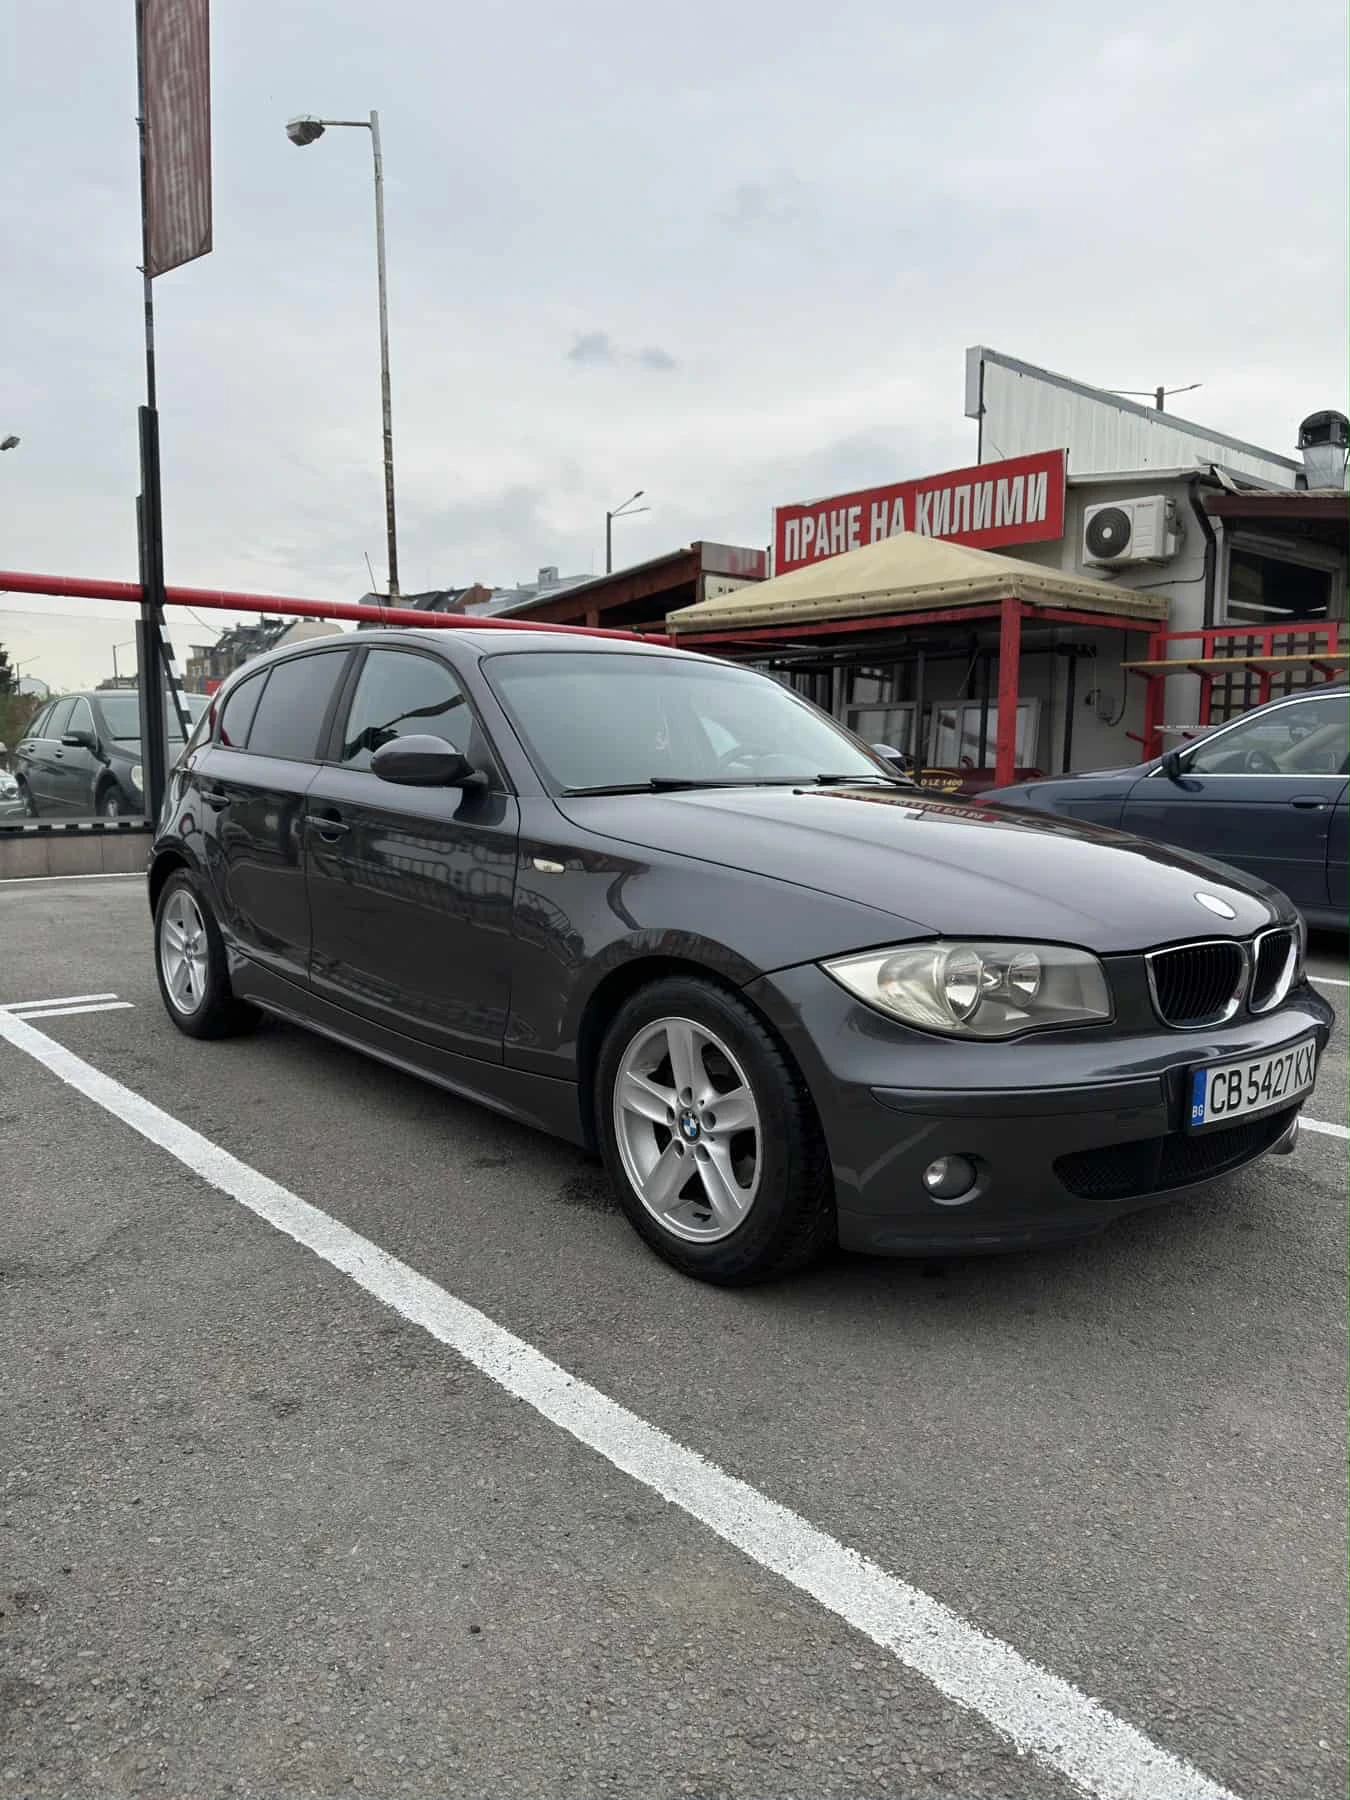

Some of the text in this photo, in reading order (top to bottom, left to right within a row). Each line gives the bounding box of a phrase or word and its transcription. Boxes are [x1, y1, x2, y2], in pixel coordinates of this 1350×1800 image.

[784, 471, 1048, 562] ПРАНЕ НА КИЛИМИ
[1192, 1105, 1204, 1118] BG
[1211, 1069, 1242, 1114] CB
[1247, 1054, 1294, 1105] 5427
